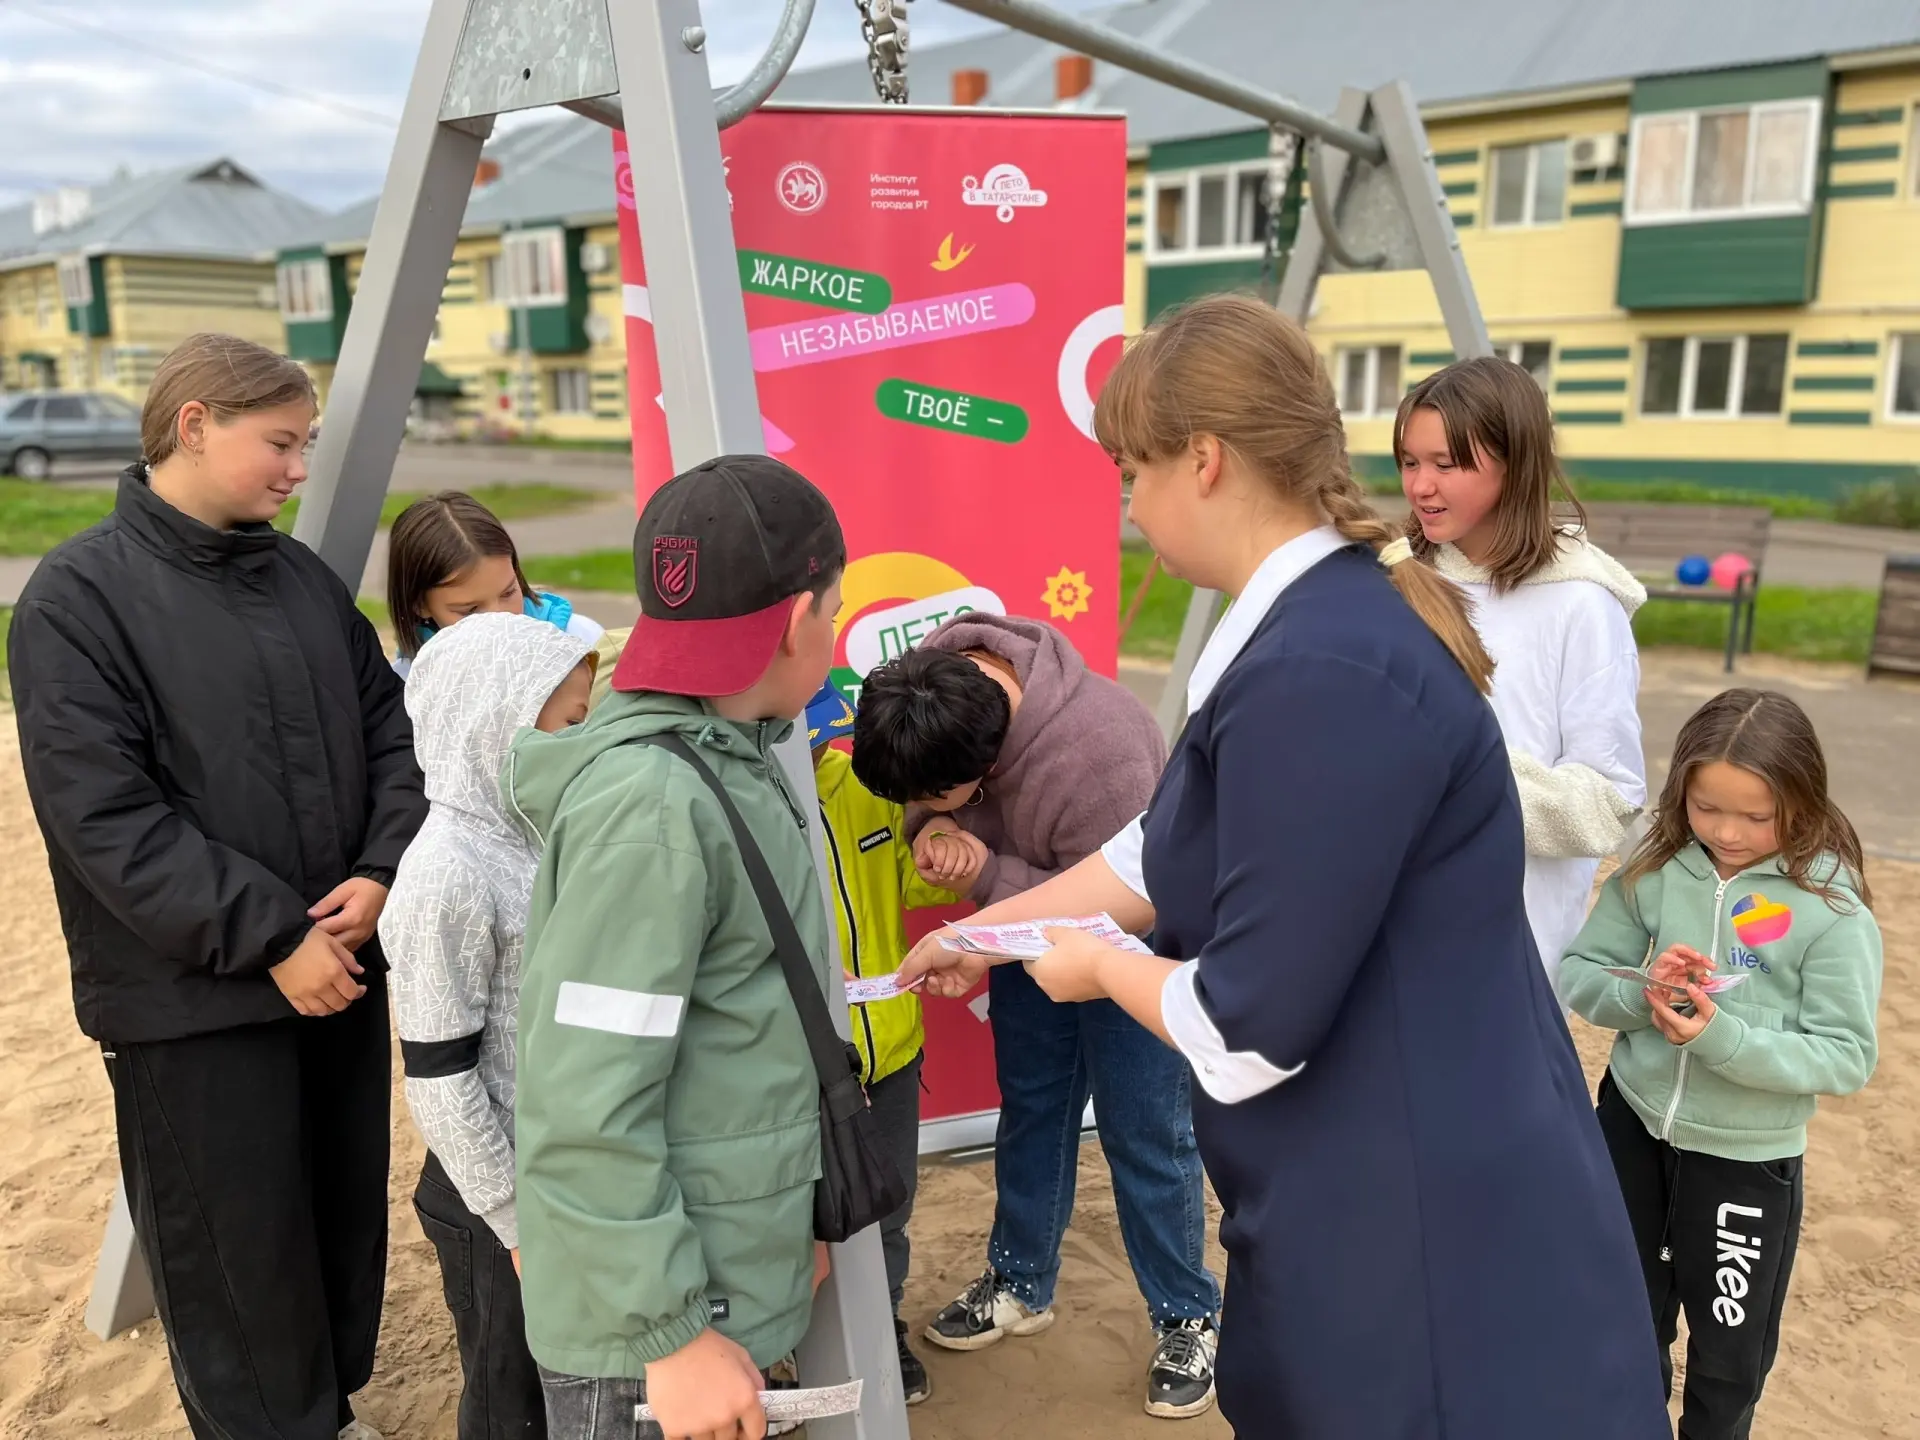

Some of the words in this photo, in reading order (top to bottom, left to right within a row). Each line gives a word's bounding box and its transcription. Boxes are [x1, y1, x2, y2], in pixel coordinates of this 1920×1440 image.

[870, 173, 918, 186] Институт
[871, 188, 920, 198] развития
[982, 192, 1041, 203] ТАТАРСТАНЕ
[871, 200, 914, 210] городов
[915, 199, 929, 210] РТ
[751, 258, 865, 304] ЖАРКОЕ
[780, 295, 997, 358] НЕЗАБЫВАЕМОЕ
[903, 389, 971, 427] ТВОЁ
[653, 536, 698, 549] РУБИН
[1726, 946, 1772, 975] ikee
[1712, 1202, 1763, 1327] Likee
